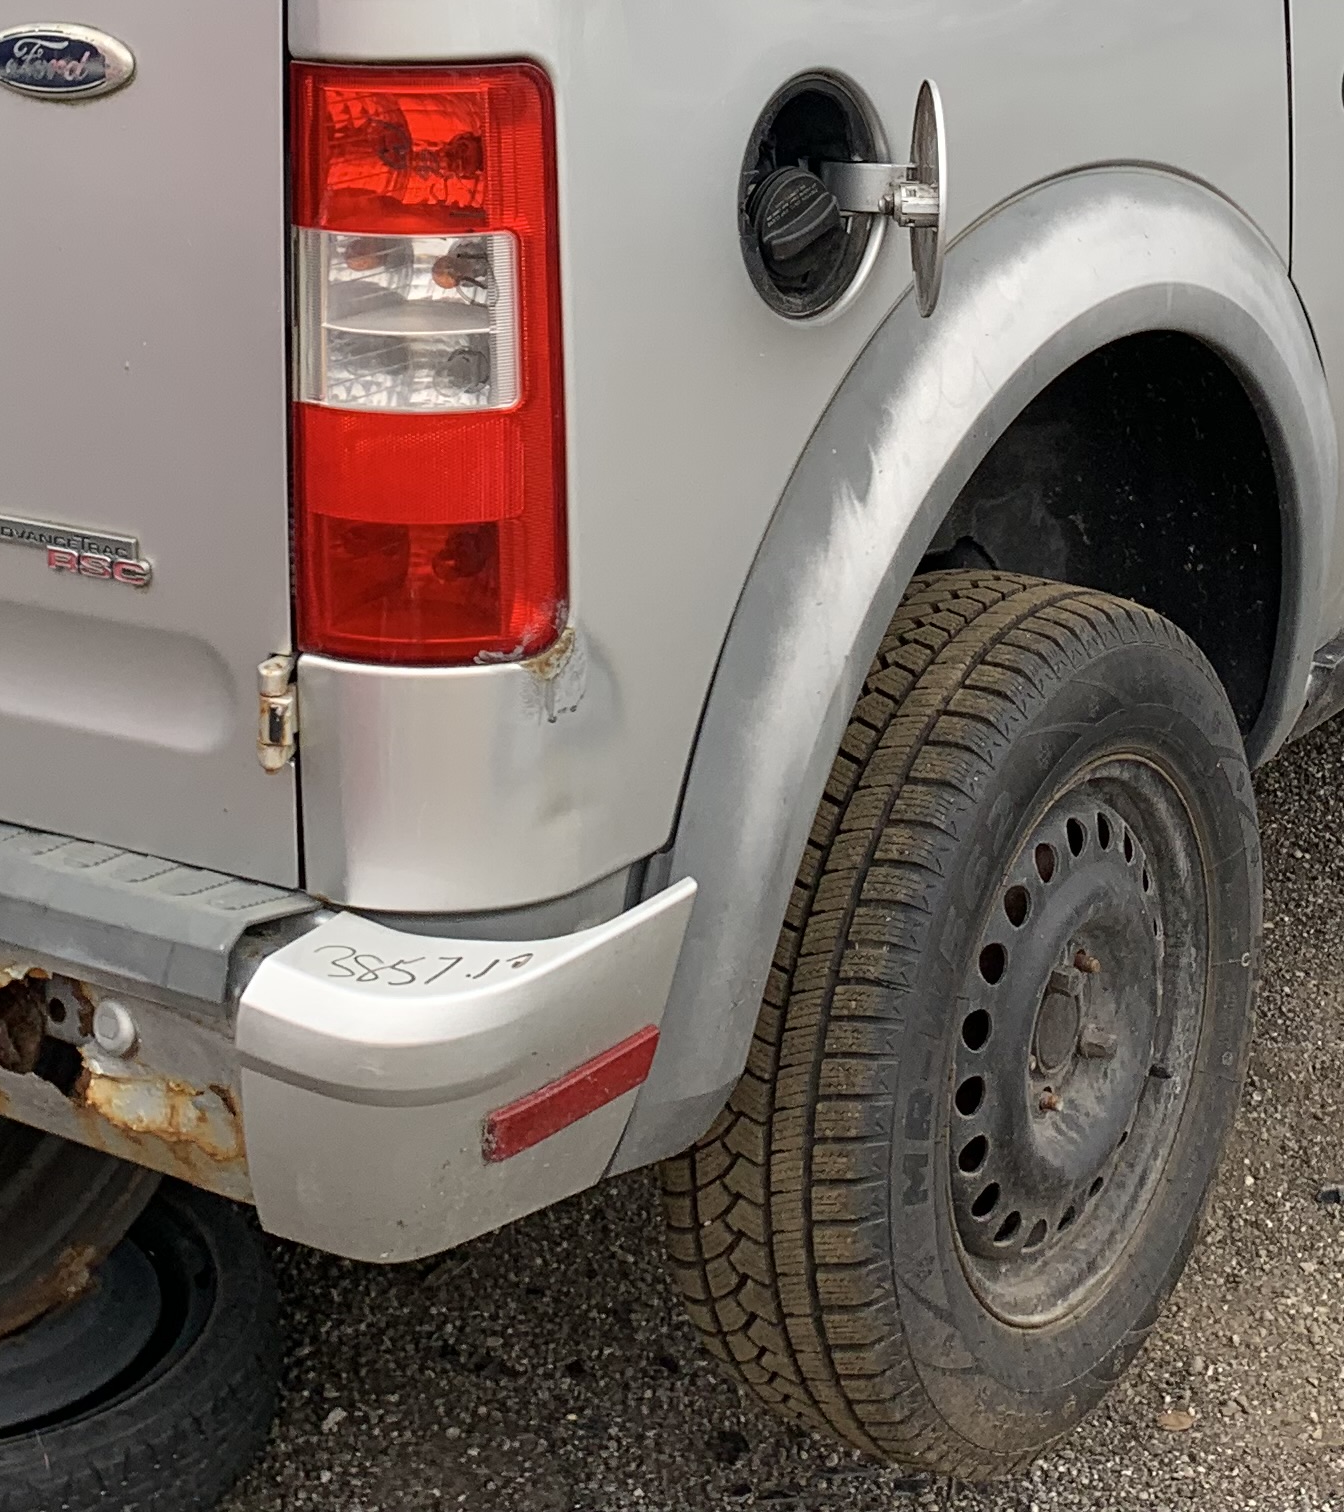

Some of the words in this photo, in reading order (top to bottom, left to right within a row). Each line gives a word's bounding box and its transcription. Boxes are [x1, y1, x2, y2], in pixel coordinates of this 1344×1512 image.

[5, 38, 89, 83] Ford
[47, 545, 152, 587] RSC
[314, 946, 534, 986] 3857.10
